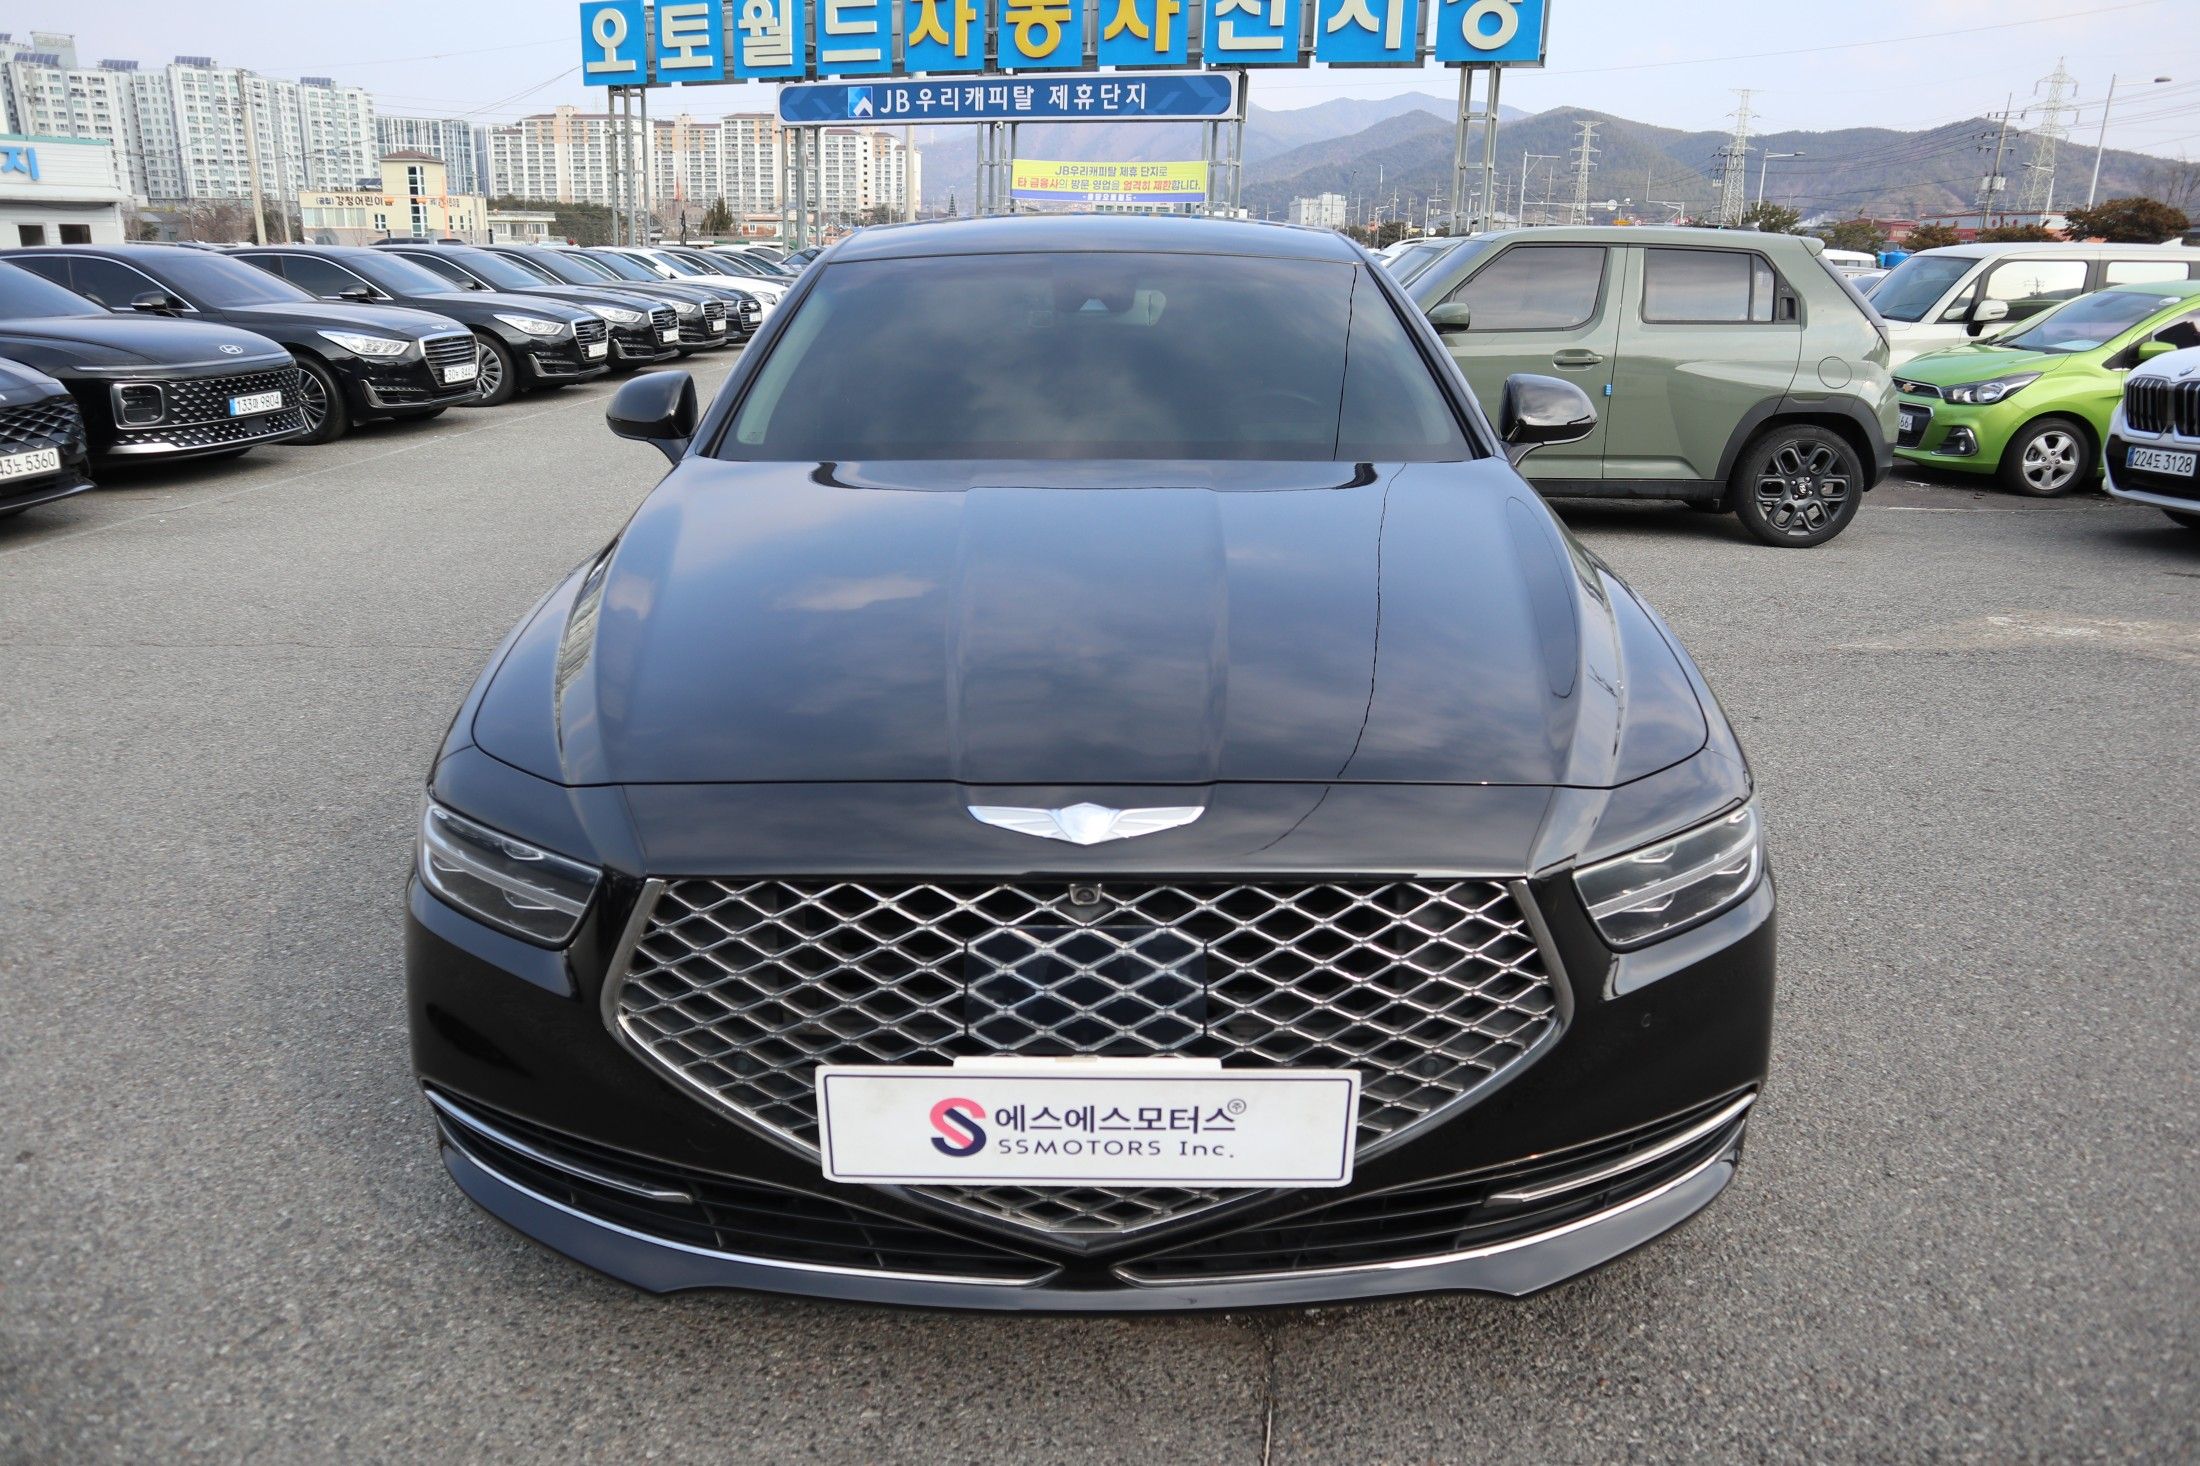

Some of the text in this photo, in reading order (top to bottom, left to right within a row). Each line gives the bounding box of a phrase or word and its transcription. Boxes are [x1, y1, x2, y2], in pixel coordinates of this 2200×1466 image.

[880, 82, 1147, 114] JB우리캐피탈 제휴단지
[1055, 165, 1167, 177] JB우리캐피탈 제휴 단지로
[1017, 177, 1027, 188] 타
[1030, 177, 1067, 189] 금융사의
[25, 451, 56, 471] 5360
[2134, 450, 2193, 473] 224도 3128
[994, 1103, 1236, 1134] 에스에스모터스
[999, 1138, 1235, 1159] SSMOTORS Inc.
